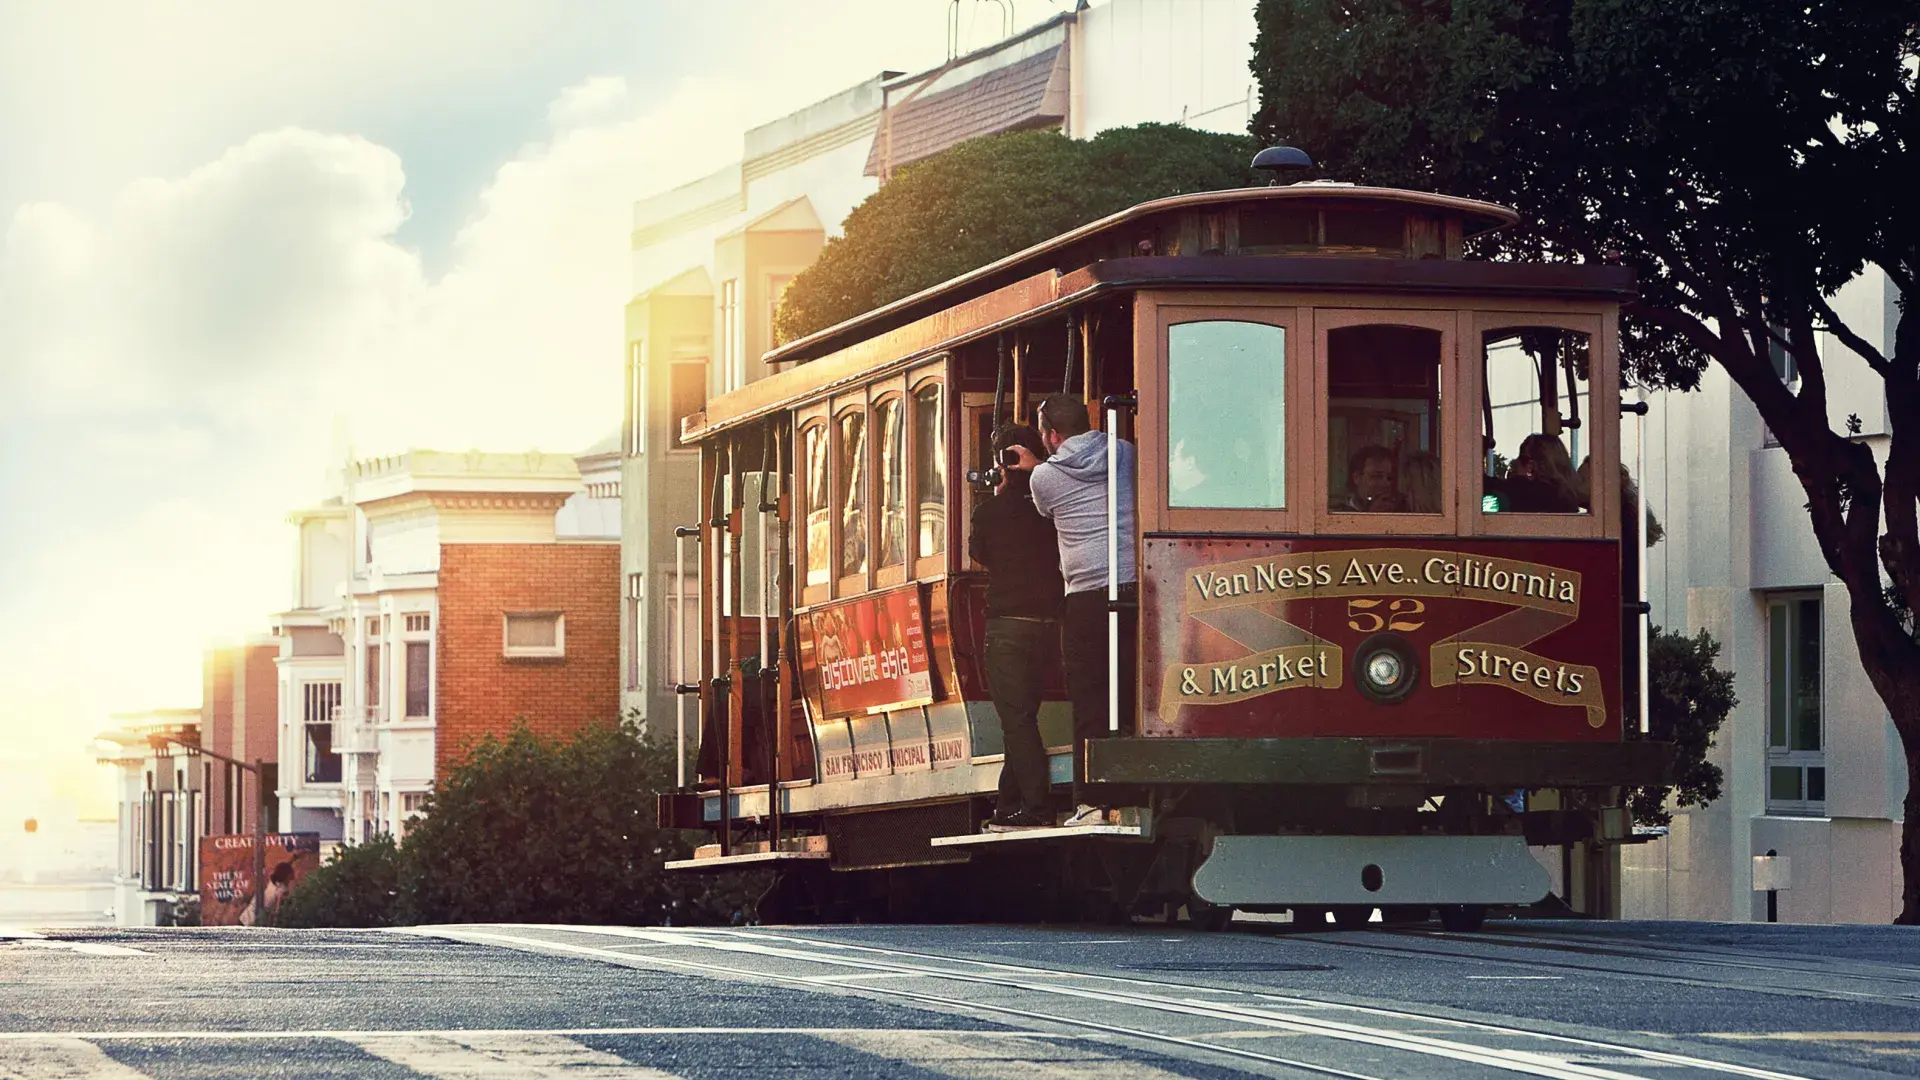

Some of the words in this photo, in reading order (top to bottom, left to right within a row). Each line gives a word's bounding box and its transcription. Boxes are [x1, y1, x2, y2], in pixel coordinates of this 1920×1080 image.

[1194, 571, 1250, 600] Van
[1253, 562, 1332, 592] Ness
[1424, 558, 1576, 603] California
[1347, 598, 1426, 632] 52
[1180, 667, 1204, 696] &
[1213, 650, 1329, 695] Market
[1458, 649, 1585, 694] Streets
[826, 757, 841, 776] SAN
